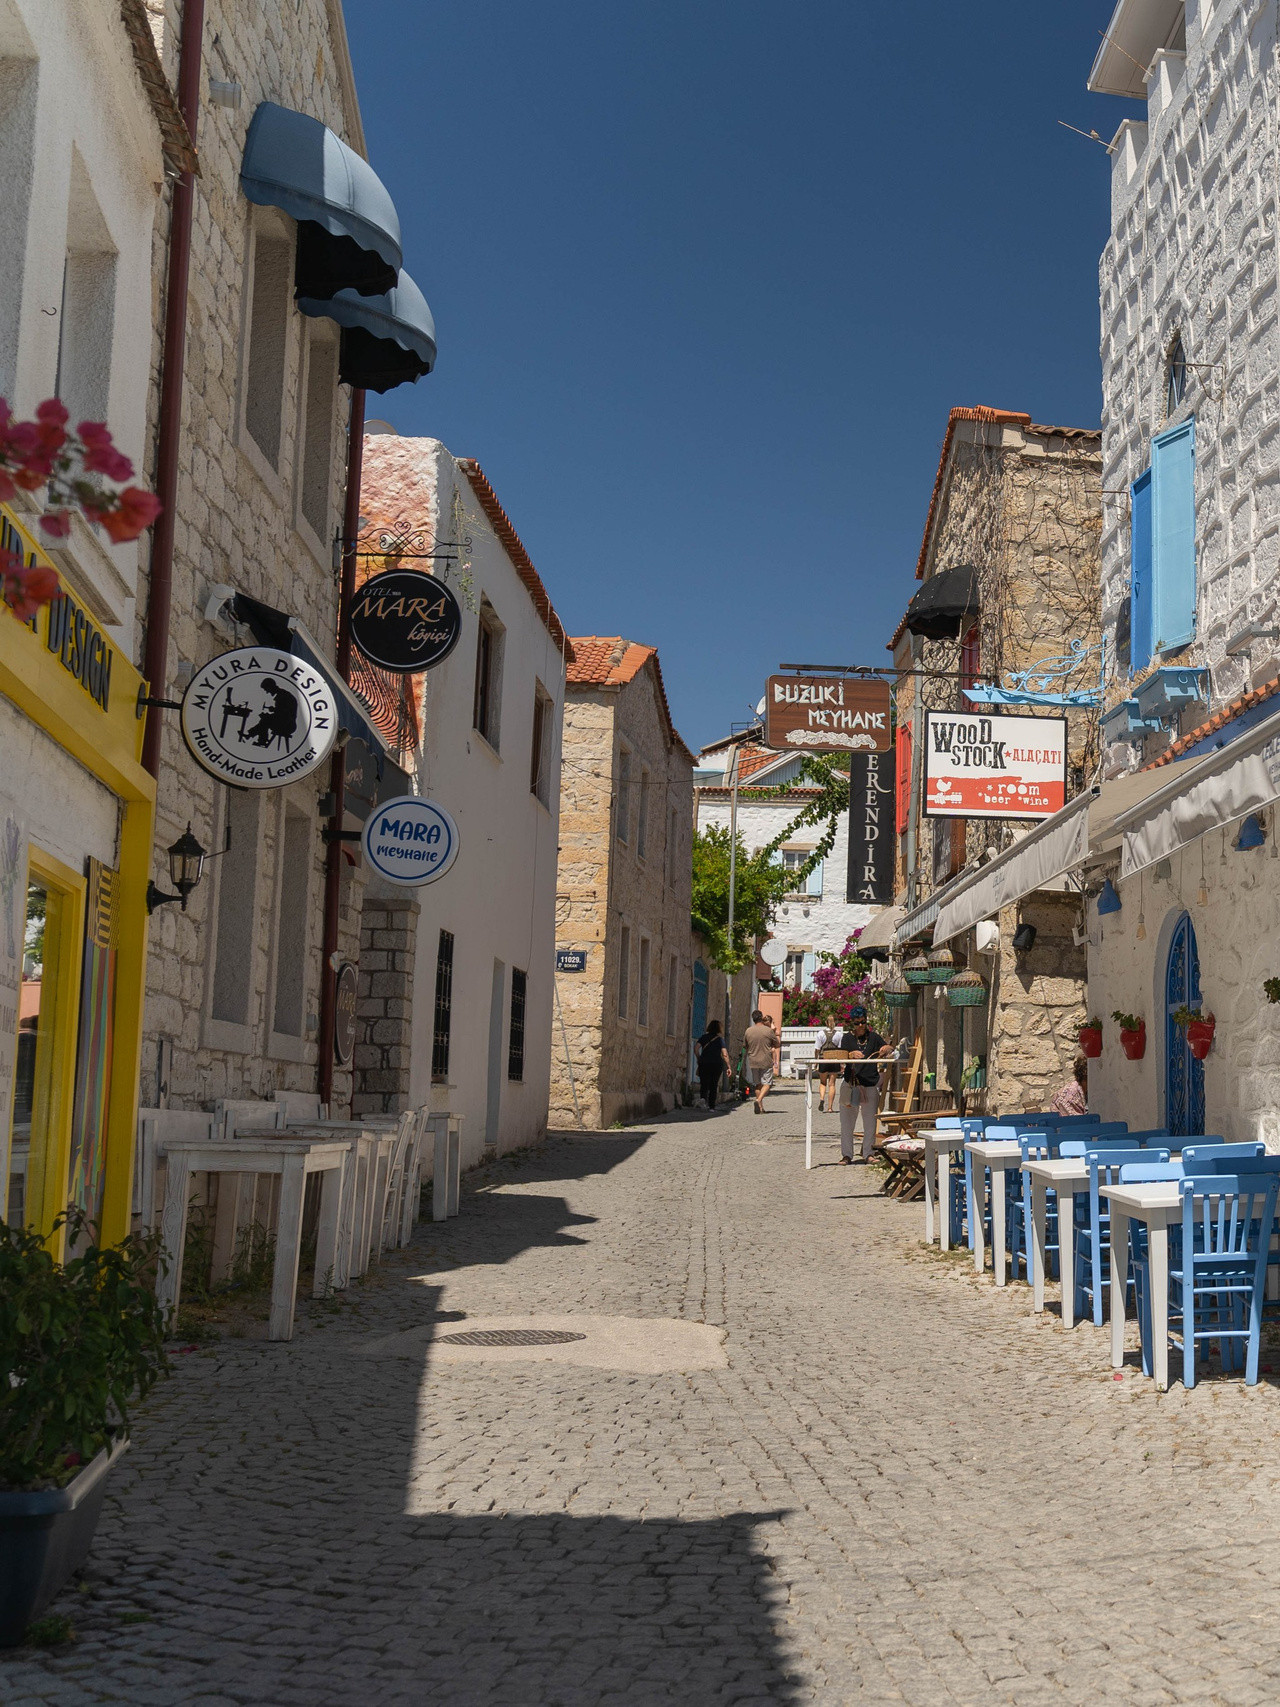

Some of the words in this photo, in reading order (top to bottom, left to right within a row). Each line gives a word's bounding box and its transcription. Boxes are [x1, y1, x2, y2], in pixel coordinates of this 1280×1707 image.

[363, 588, 391, 596] OTEL
[351, 597, 446, 623] MARA
[48, 586, 114, 713] DESIGN
[191, 656, 262, 710] MYURA
[274, 658, 330, 730] DESIGN
[192, 727, 263, 780] Hand-Made
[267, 746, 318, 780] Leather
[950, 741, 1007, 769] STOCK
[1013, 748, 1062, 765] ALAÇATI
[984, 793, 1011, 804] beer
[1022, 796, 1049, 806] wine
[997, 783, 1040, 796] room
[380, 818, 441, 844] MARA
